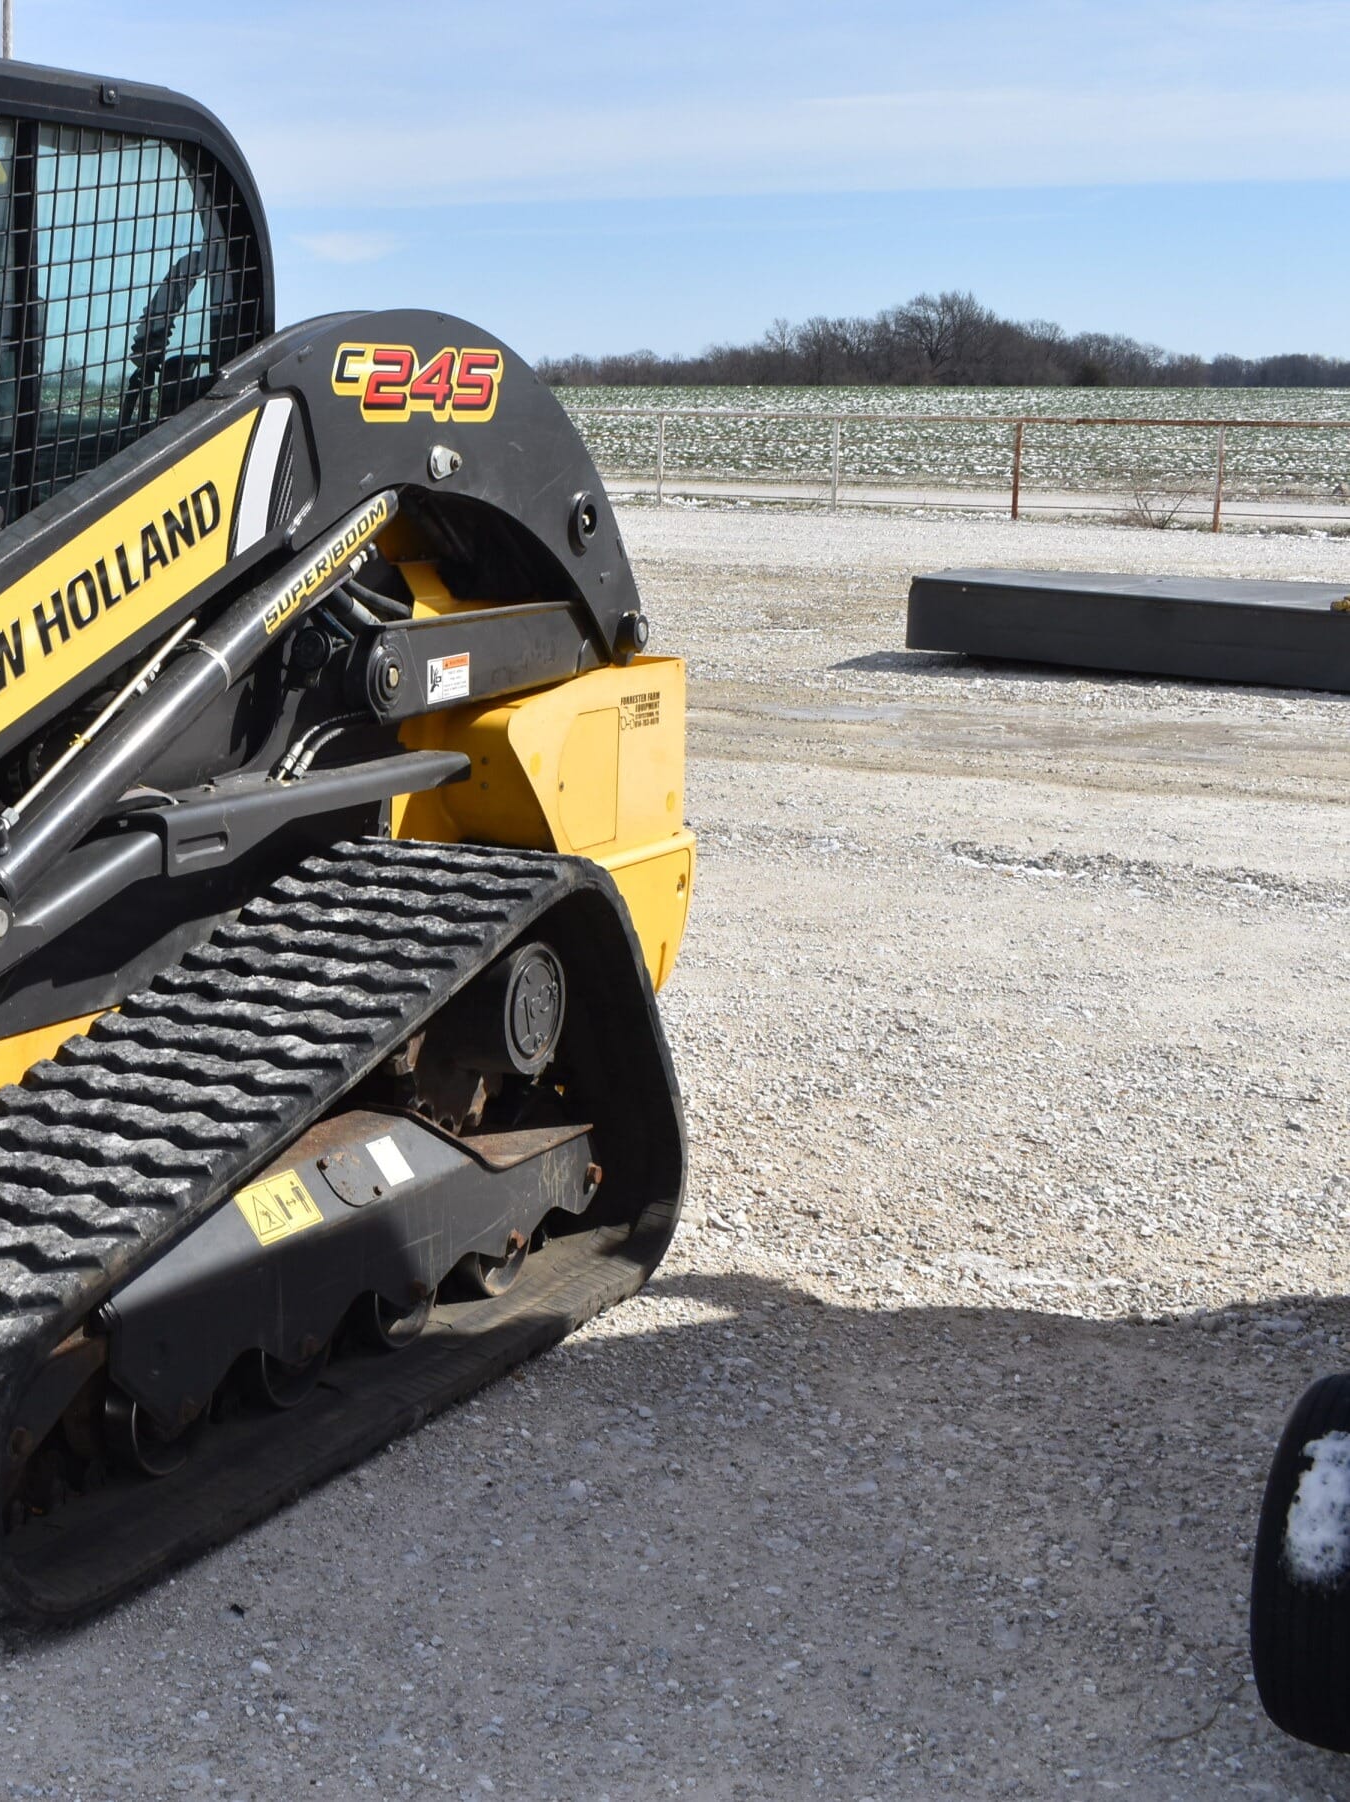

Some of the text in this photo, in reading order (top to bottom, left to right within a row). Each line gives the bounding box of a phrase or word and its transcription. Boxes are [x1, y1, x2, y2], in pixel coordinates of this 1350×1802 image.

[334, 346, 501, 416] C245
[32, 479, 221, 657] HOLLAND
[647, 691, 660, 701] FARM
